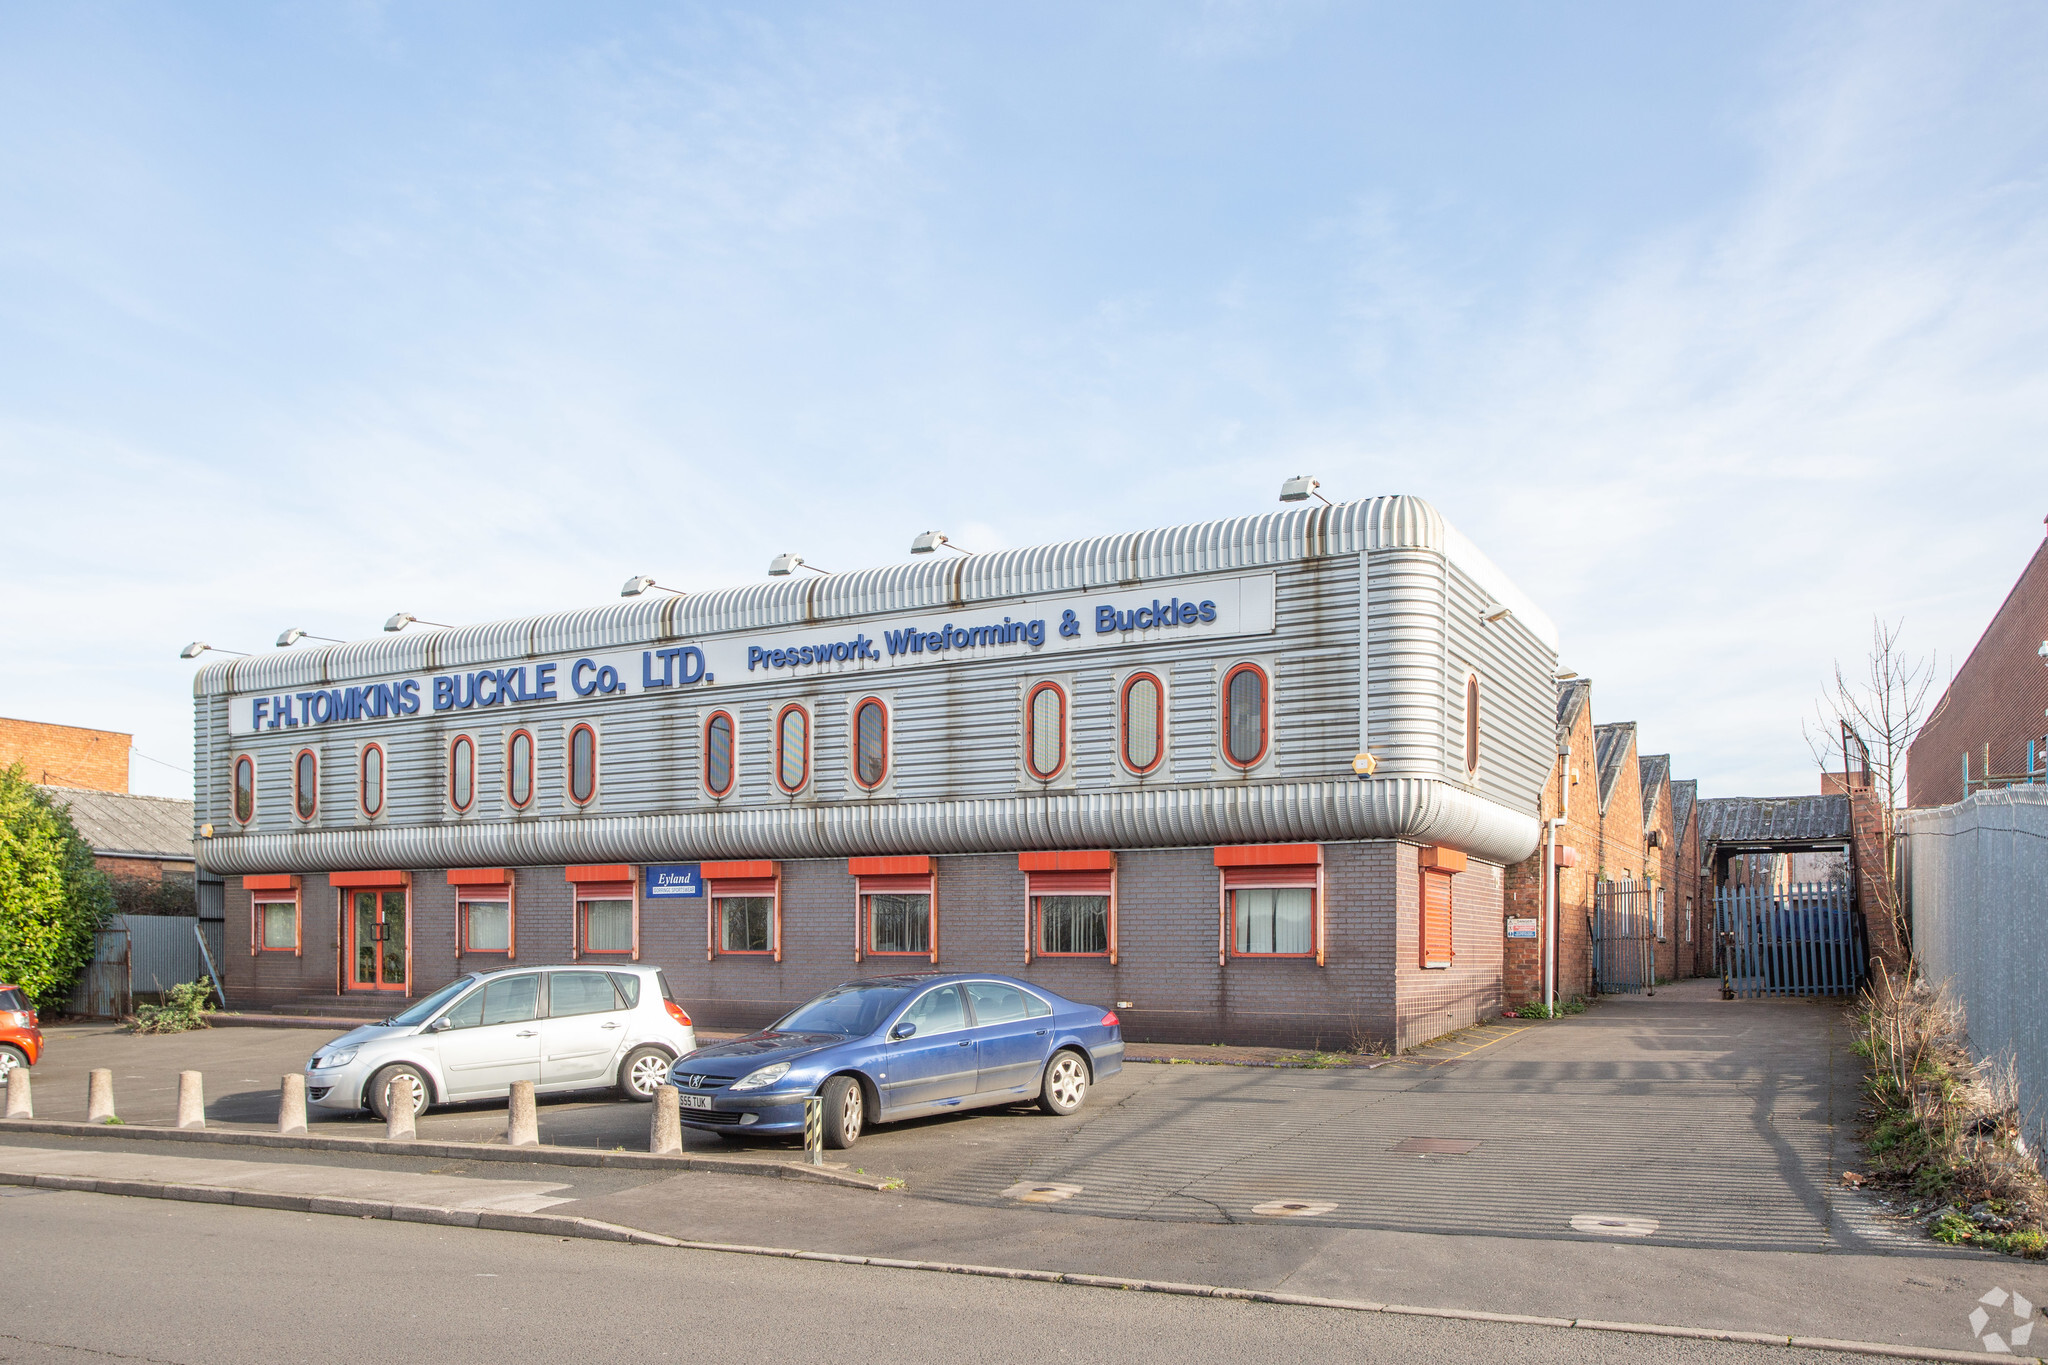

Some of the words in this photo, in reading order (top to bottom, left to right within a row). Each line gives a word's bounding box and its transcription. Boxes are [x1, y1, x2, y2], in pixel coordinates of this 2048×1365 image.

[748, 633, 880, 671] Presswork,
[884, 616, 1046, 655] Wireforming
[1059, 608, 1081, 637] &
[1095, 597, 1217, 633] Buckles
[433, 662, 557, 710] BUCKLE
[571, 657, 627, 696] Co.
[642, 645, 714, 688] LTD.
[658, 872, 691, 886] Eyland
[680, 1096, 692, 1106] S55
[692, 1096, 706, 1108] TUK
